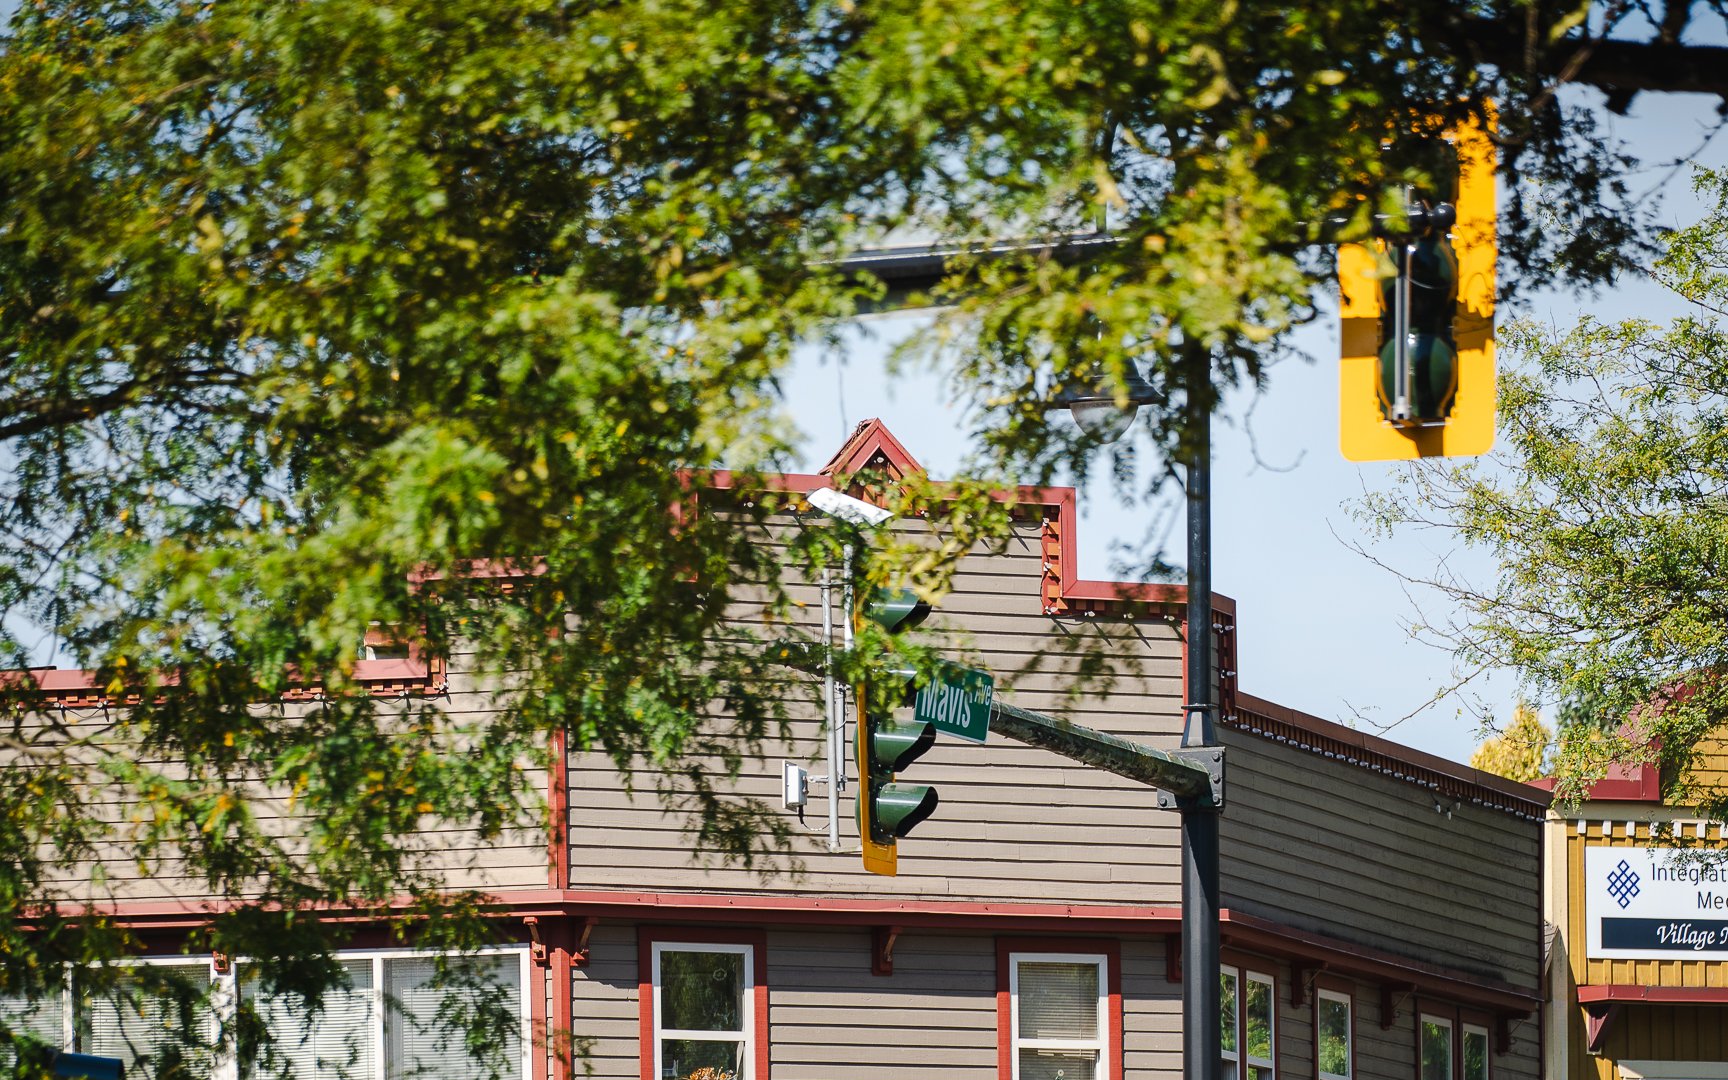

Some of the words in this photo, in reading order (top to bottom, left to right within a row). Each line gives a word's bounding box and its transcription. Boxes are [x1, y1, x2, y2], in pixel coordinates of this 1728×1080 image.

[921, 678, 972, 728] Mavis
[1697, 891, 1728, 909] Me
[1656, 923, 1715, 950] Village
